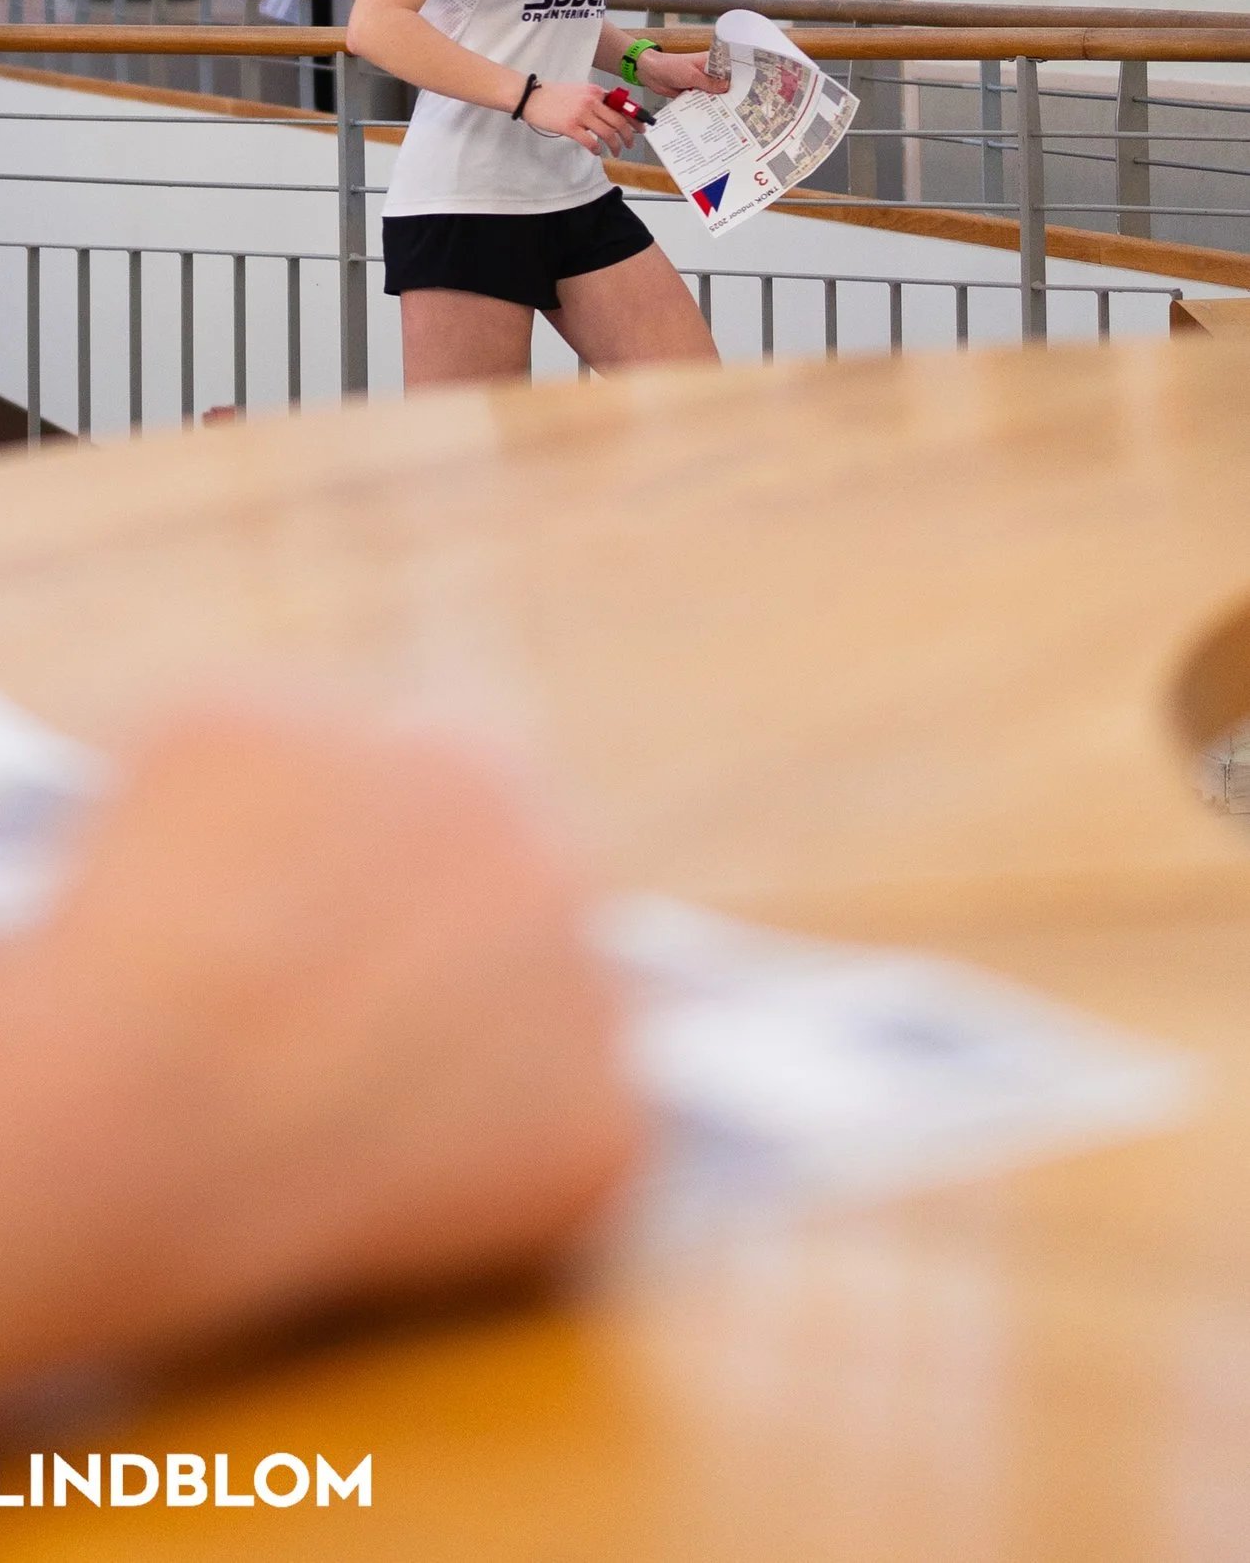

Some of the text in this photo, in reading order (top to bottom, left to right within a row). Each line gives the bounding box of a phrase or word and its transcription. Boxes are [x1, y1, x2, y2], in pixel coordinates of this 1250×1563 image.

[753, 170, 769, 186] 3
[708, 186, 780, 233] TMOK Indoor 2025
